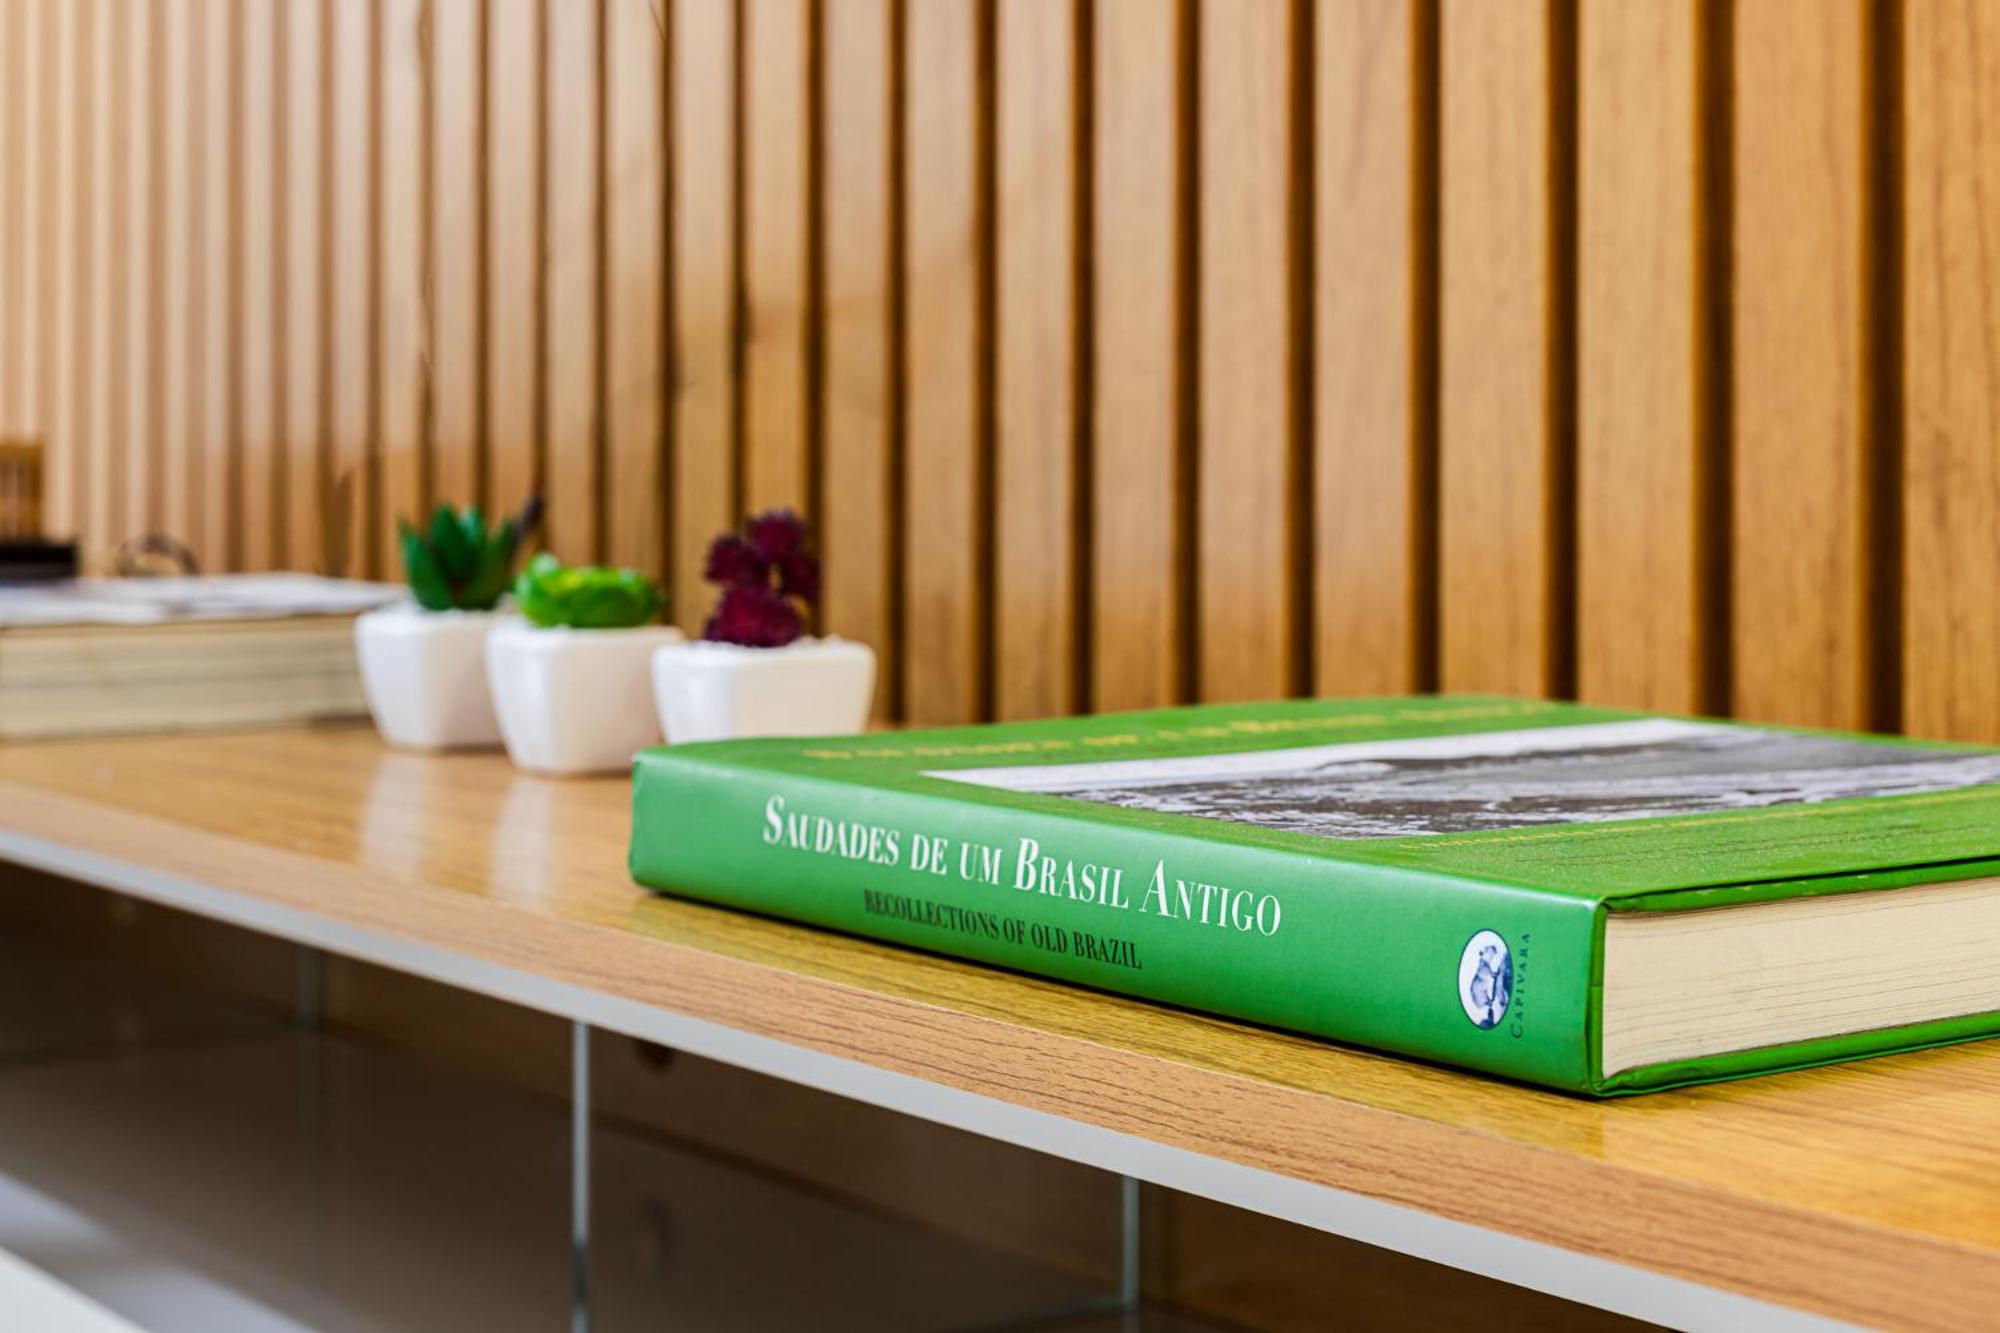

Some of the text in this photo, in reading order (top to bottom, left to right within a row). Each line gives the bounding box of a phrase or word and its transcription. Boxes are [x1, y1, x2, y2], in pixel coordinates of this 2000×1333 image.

[763, 795, 1281, 936] SAUDADES DE UM BRASIL ANTIGO
[864, 889, 1142, 969] RECOLLECTIONS OF OLD BRAZIL
[1510, 933, 1530, 1039] CAPIVARA
